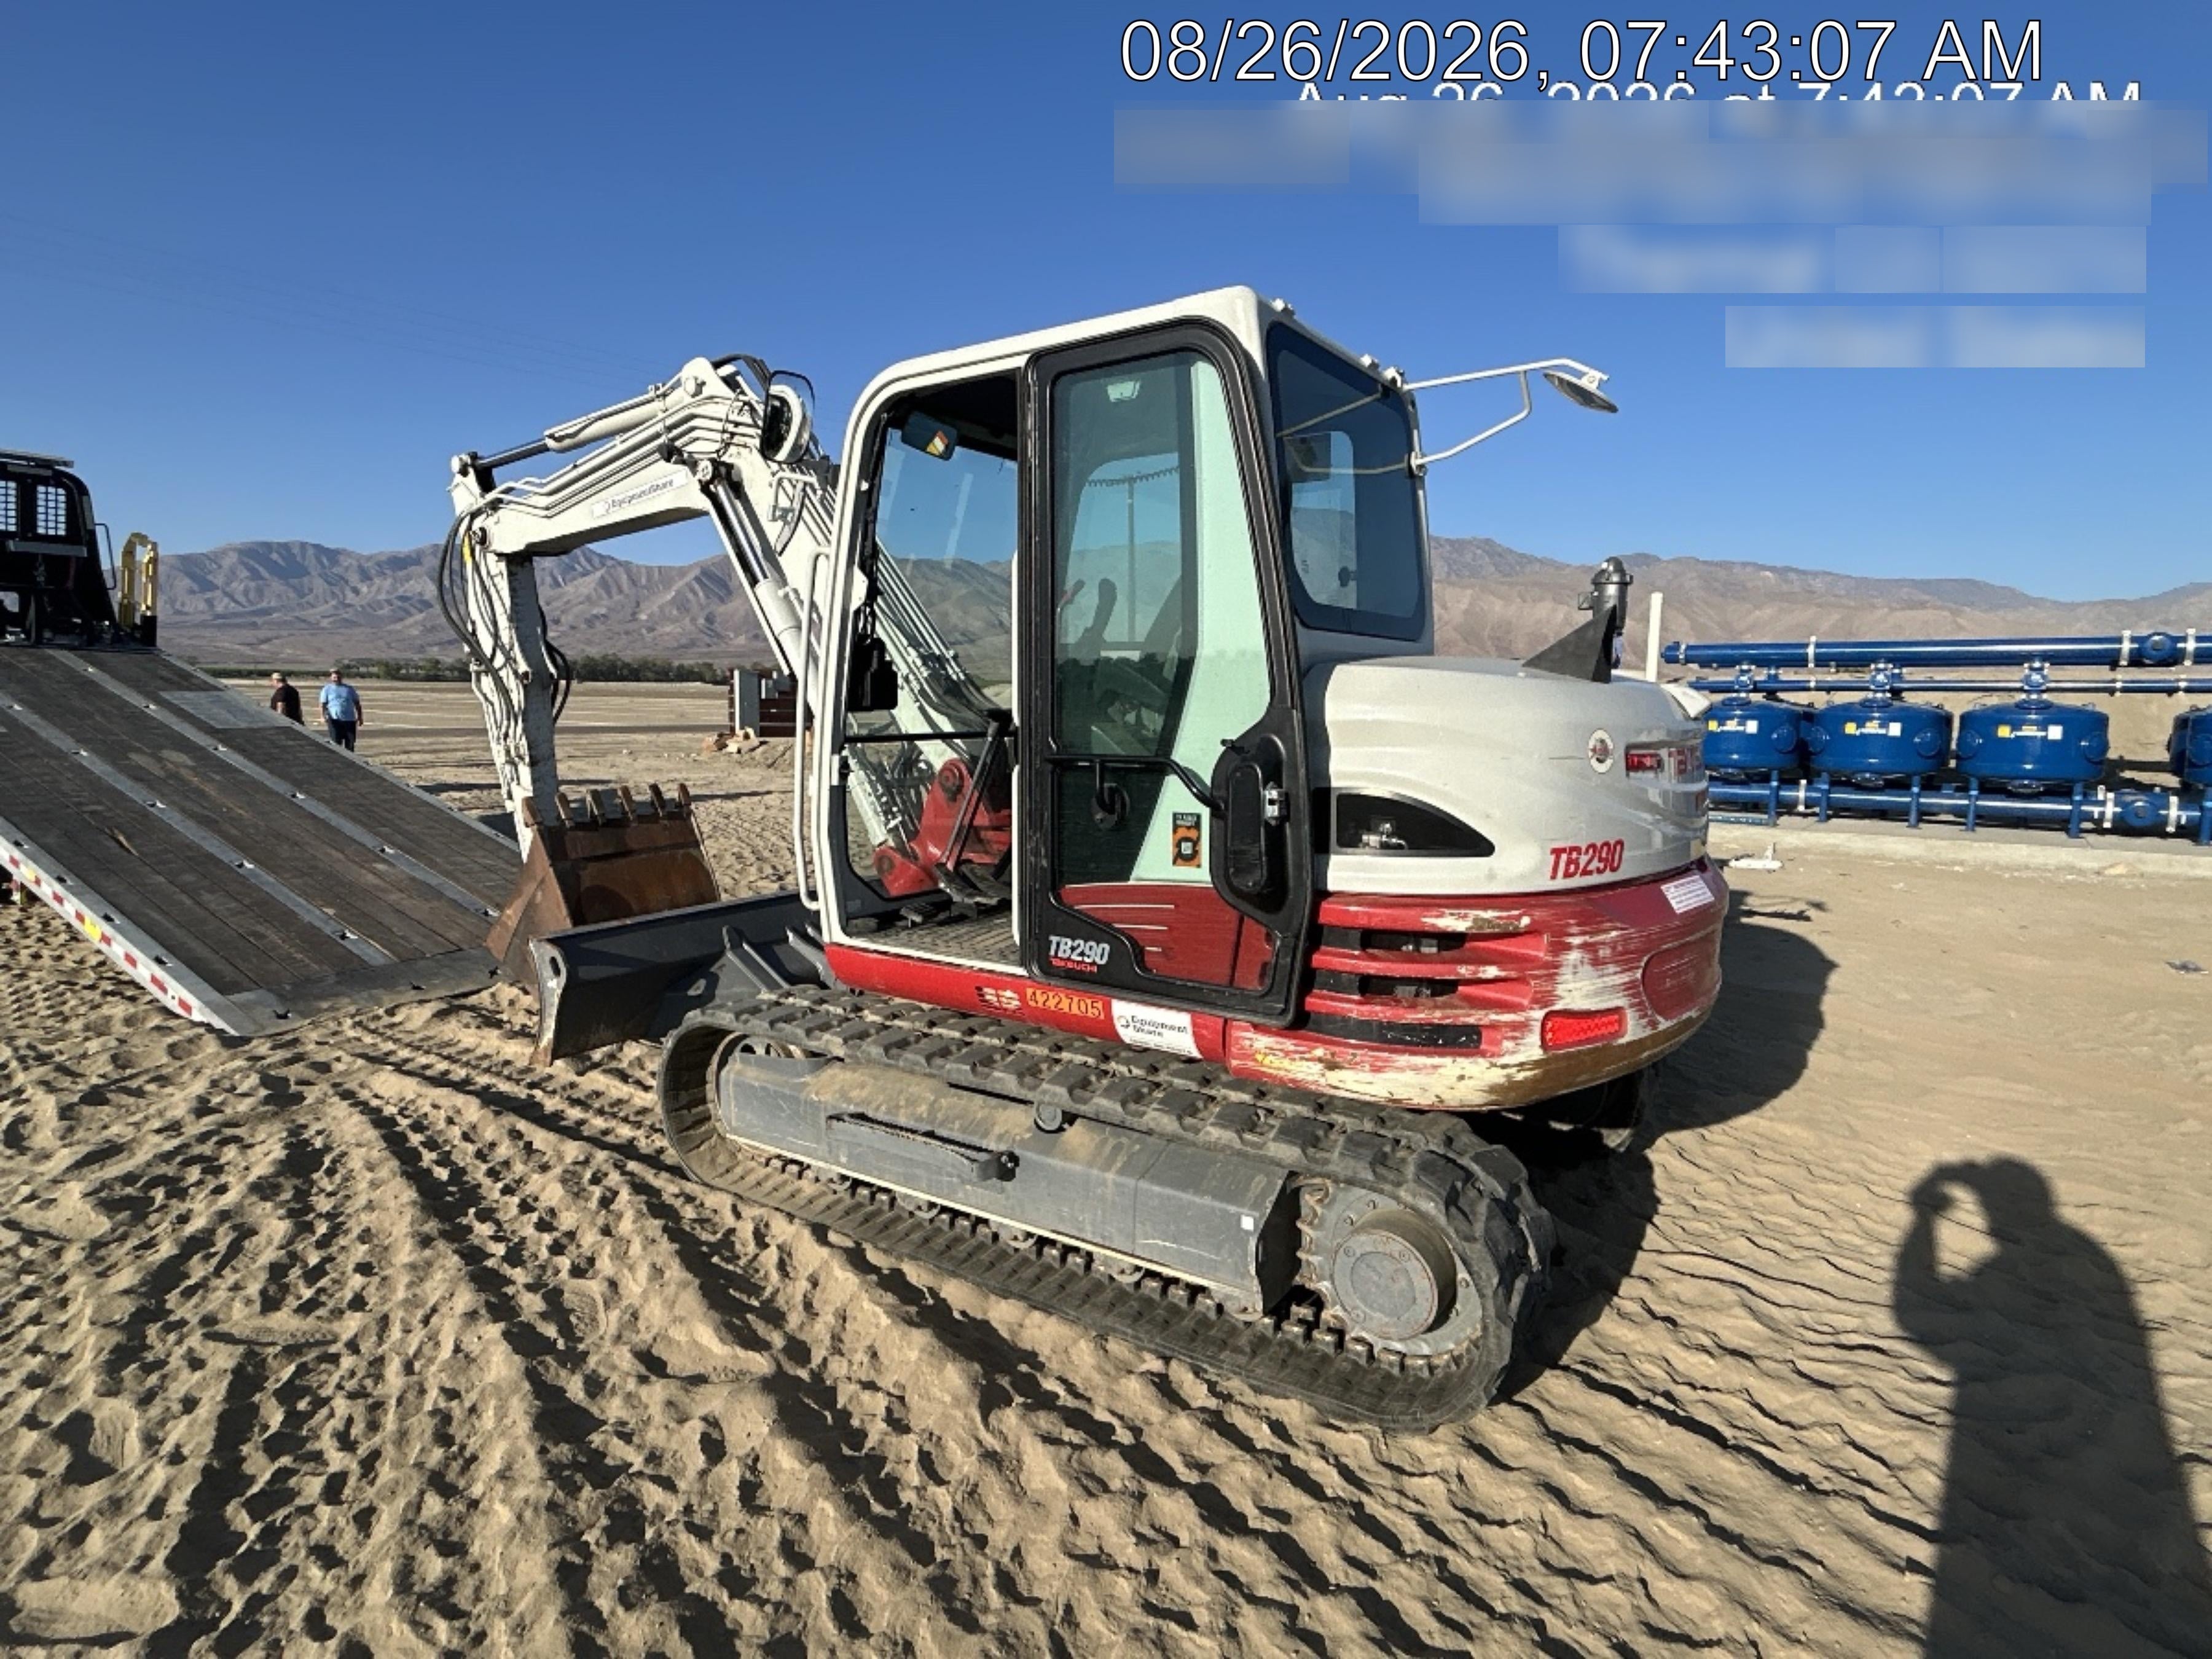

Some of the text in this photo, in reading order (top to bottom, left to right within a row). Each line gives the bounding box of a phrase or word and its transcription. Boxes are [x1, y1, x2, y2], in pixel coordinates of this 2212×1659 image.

[1550, 838, 1625, 880] TB290
[1048, 935, 1111, 965] TB290
[1029, 989, 1102, 1019] 422705
